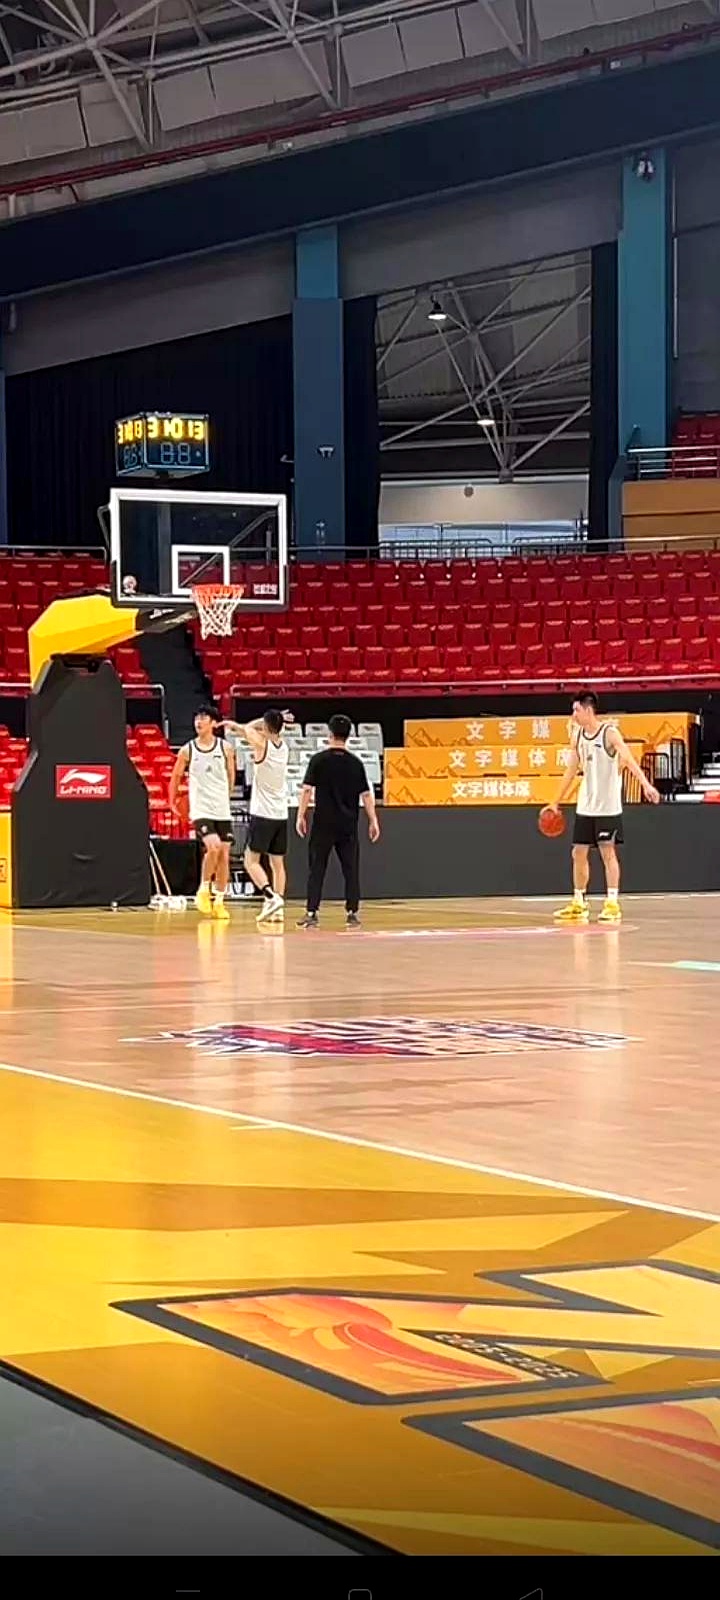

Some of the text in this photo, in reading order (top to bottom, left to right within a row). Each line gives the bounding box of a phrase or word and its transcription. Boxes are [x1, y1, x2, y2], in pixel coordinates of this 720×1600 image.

[60, 785, 107, 795] LI-NING
[452, 780, 530, 797] 文字媒体席
